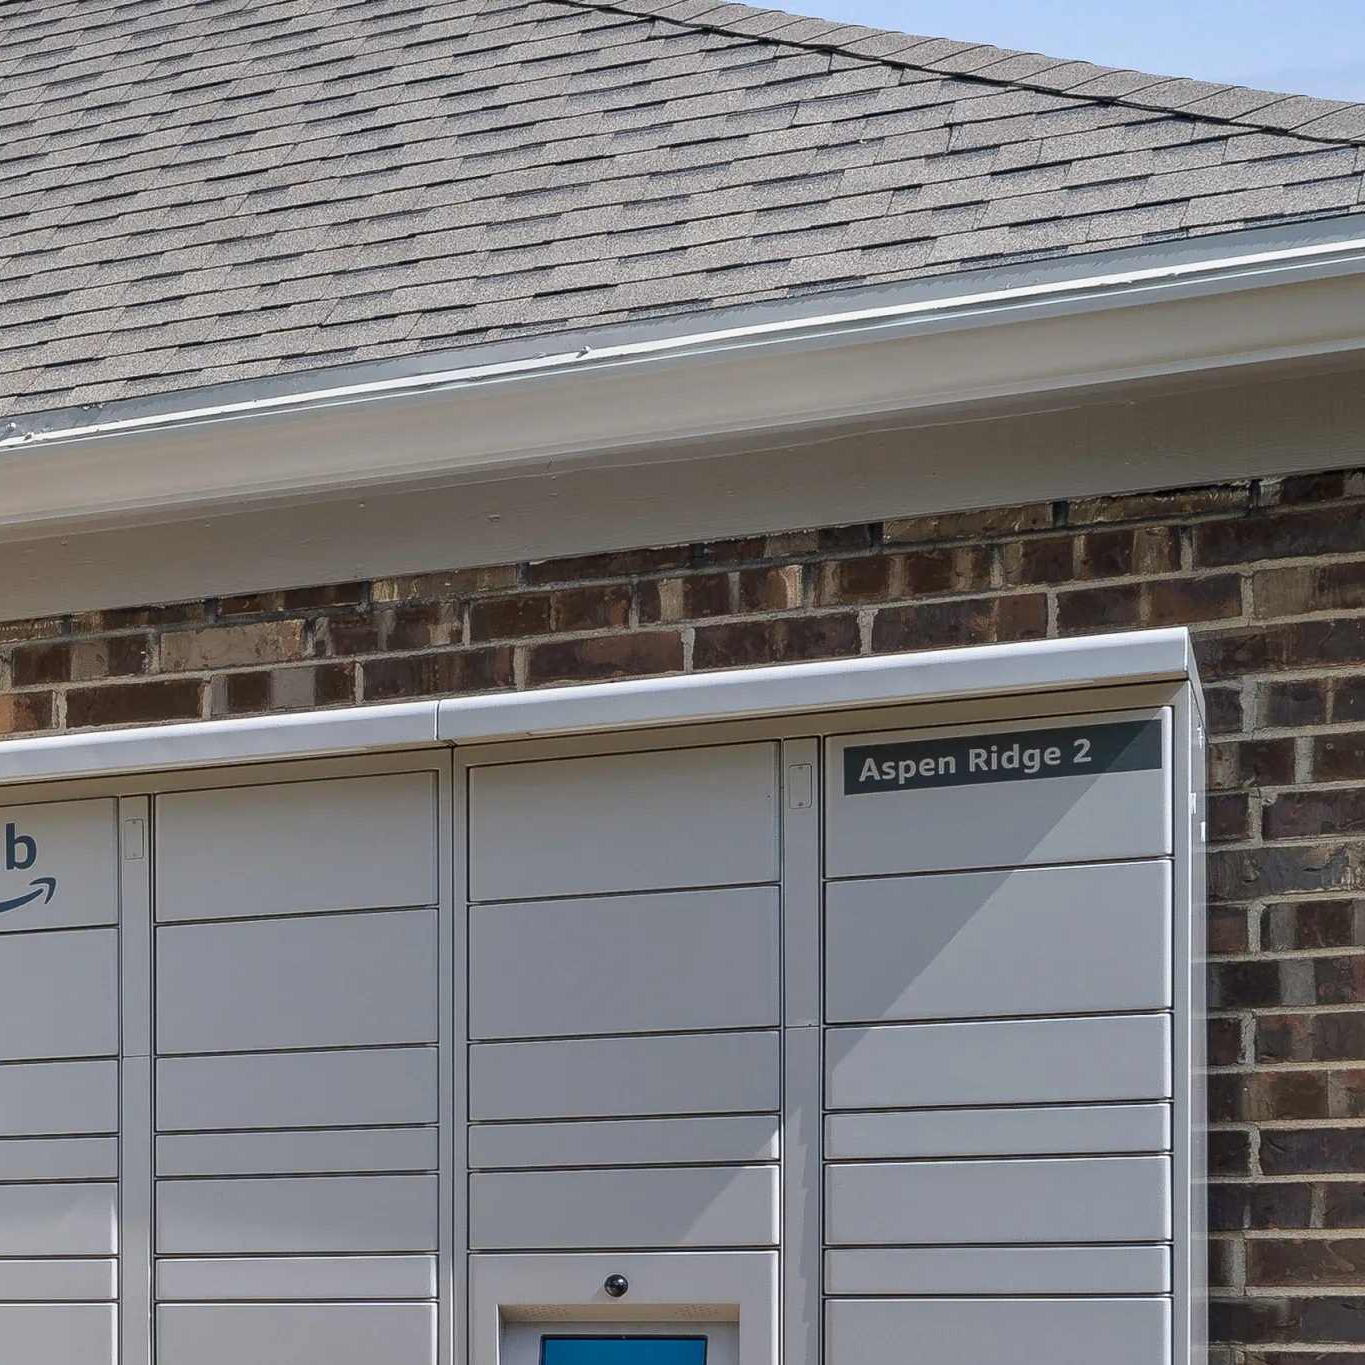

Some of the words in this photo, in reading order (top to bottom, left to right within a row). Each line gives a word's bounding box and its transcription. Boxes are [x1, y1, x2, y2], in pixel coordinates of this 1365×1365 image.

[859, 753, 956, 784] Aspen
[968, 743, 1061, 773] Ridge
[1072, 738, 1092, 763] 2
